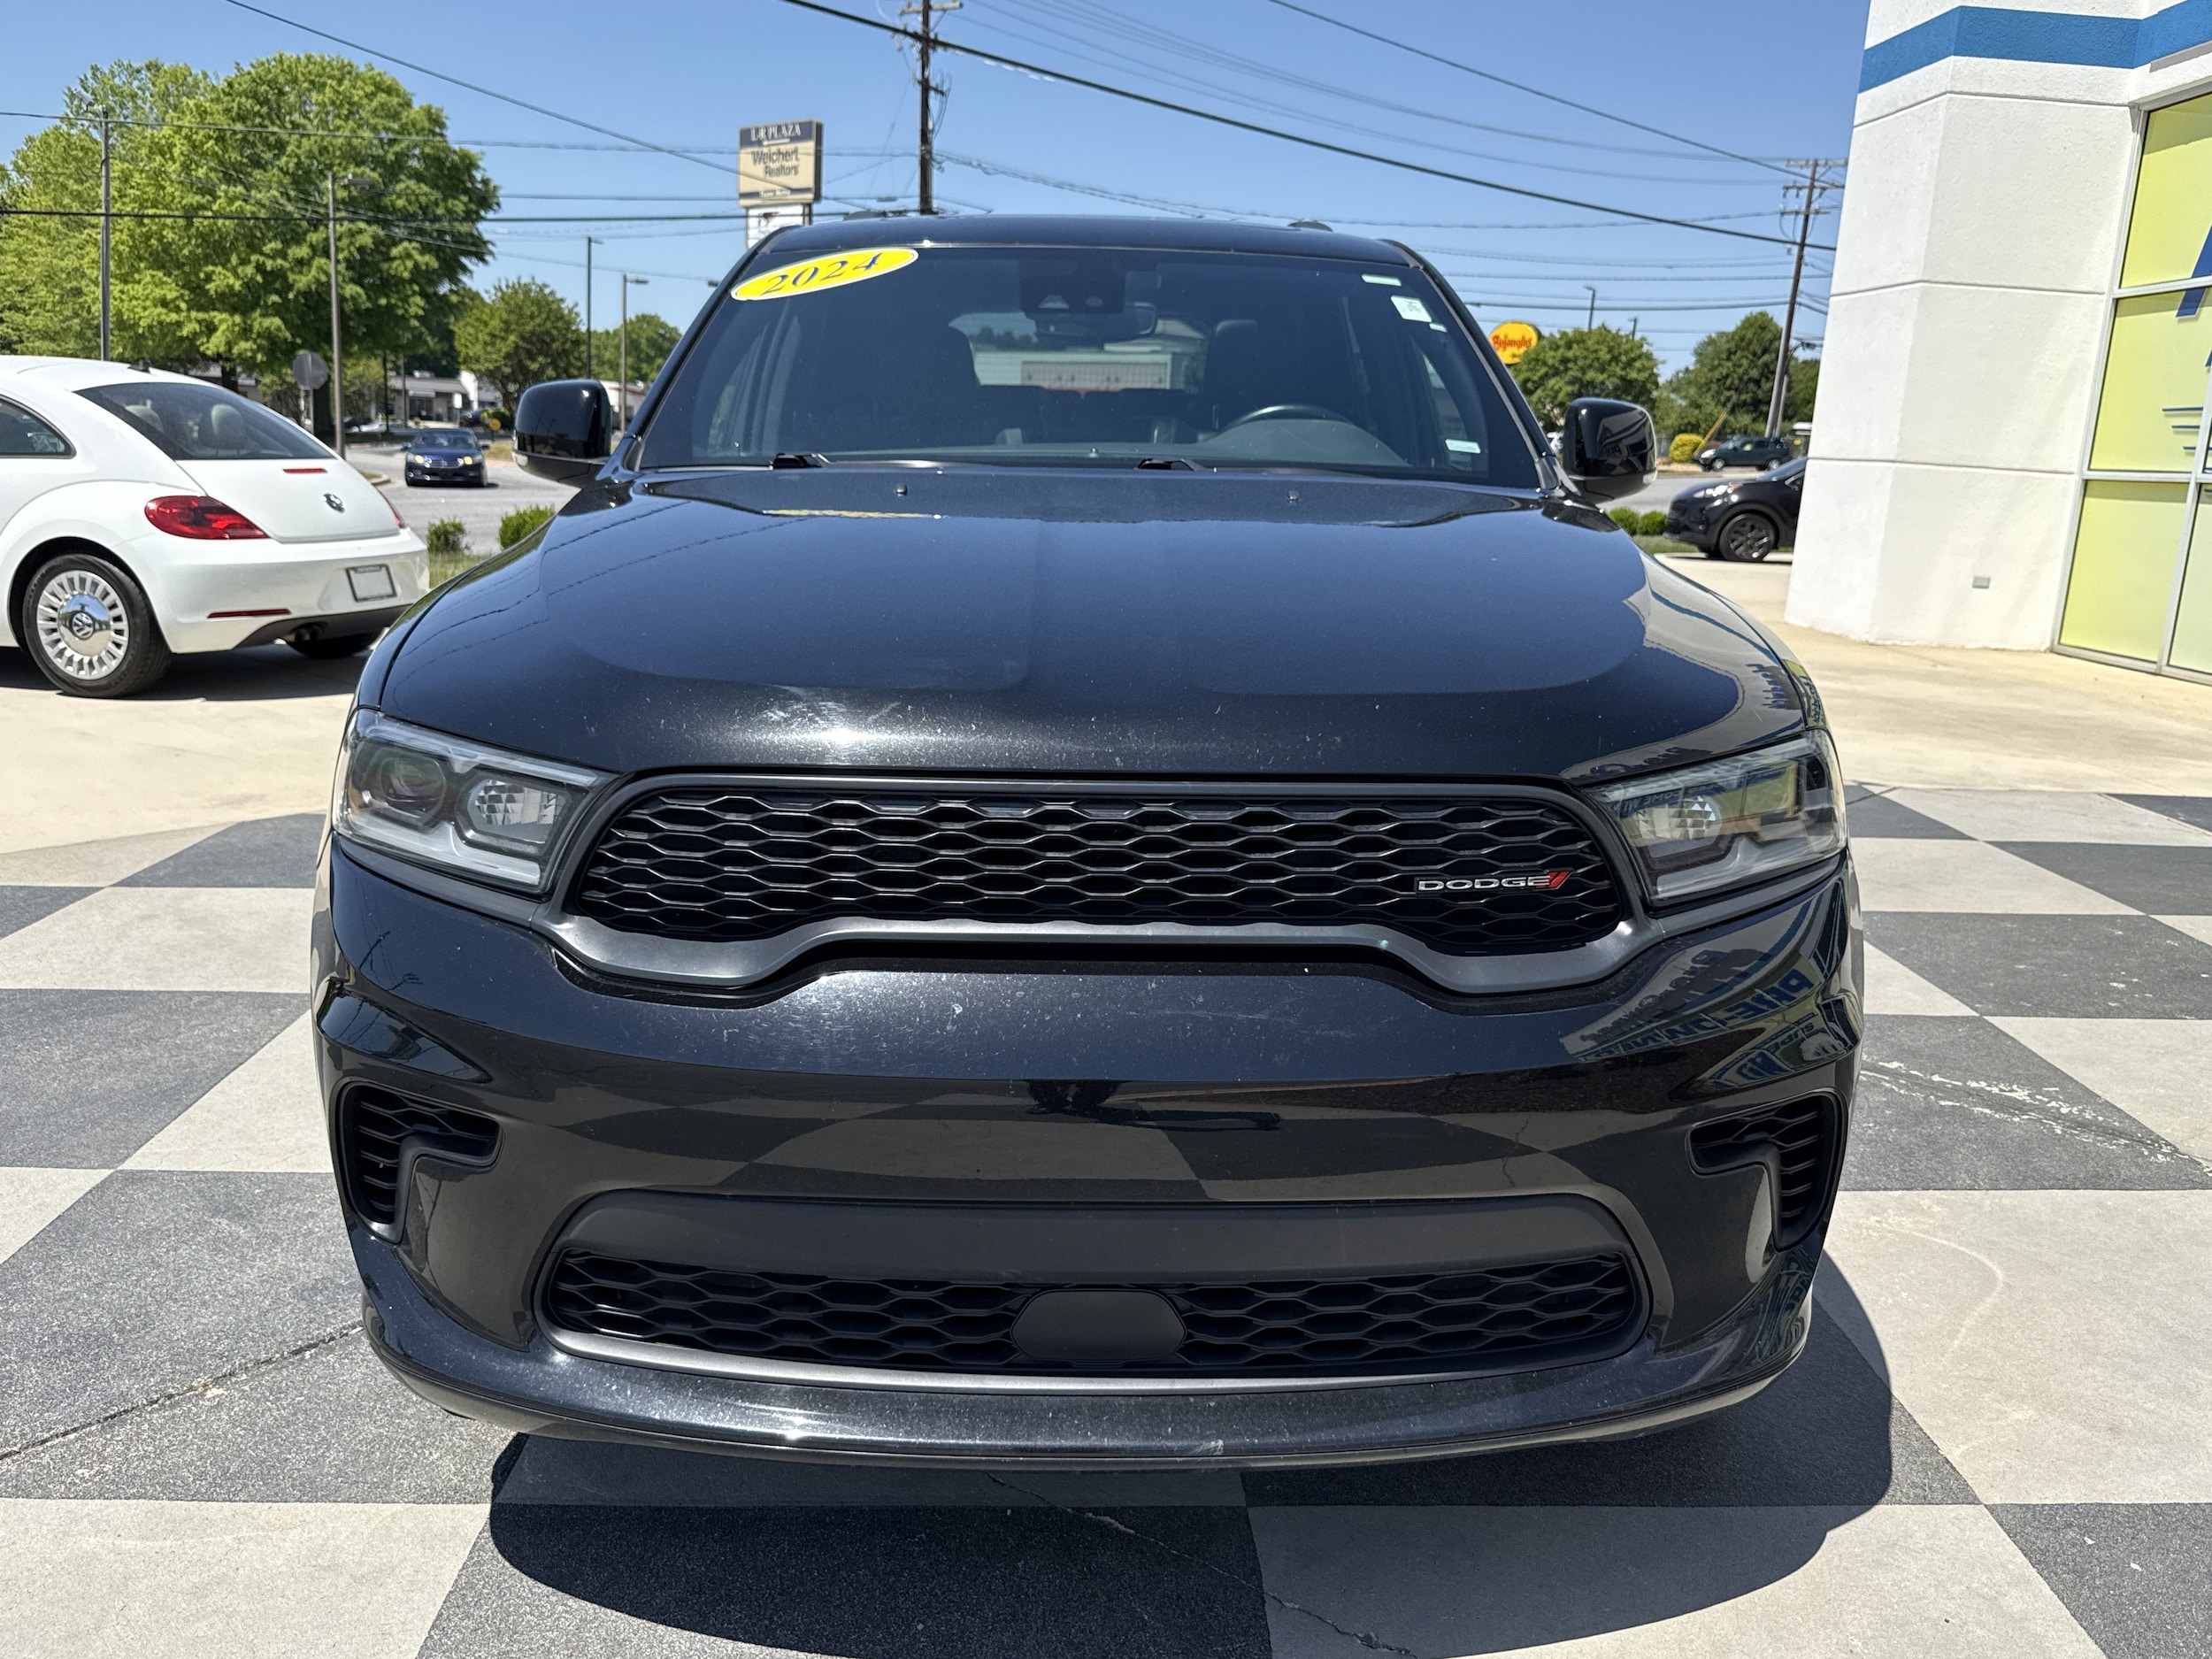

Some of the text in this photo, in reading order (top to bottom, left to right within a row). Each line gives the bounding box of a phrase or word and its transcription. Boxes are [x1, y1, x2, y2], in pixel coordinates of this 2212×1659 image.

[751, 146, 800, 166] Weichert
[764, 164, 800, 178] Realtors
[759, 252, 883, 296] 2024
[1418, 875, 1550, 891] DODGE
